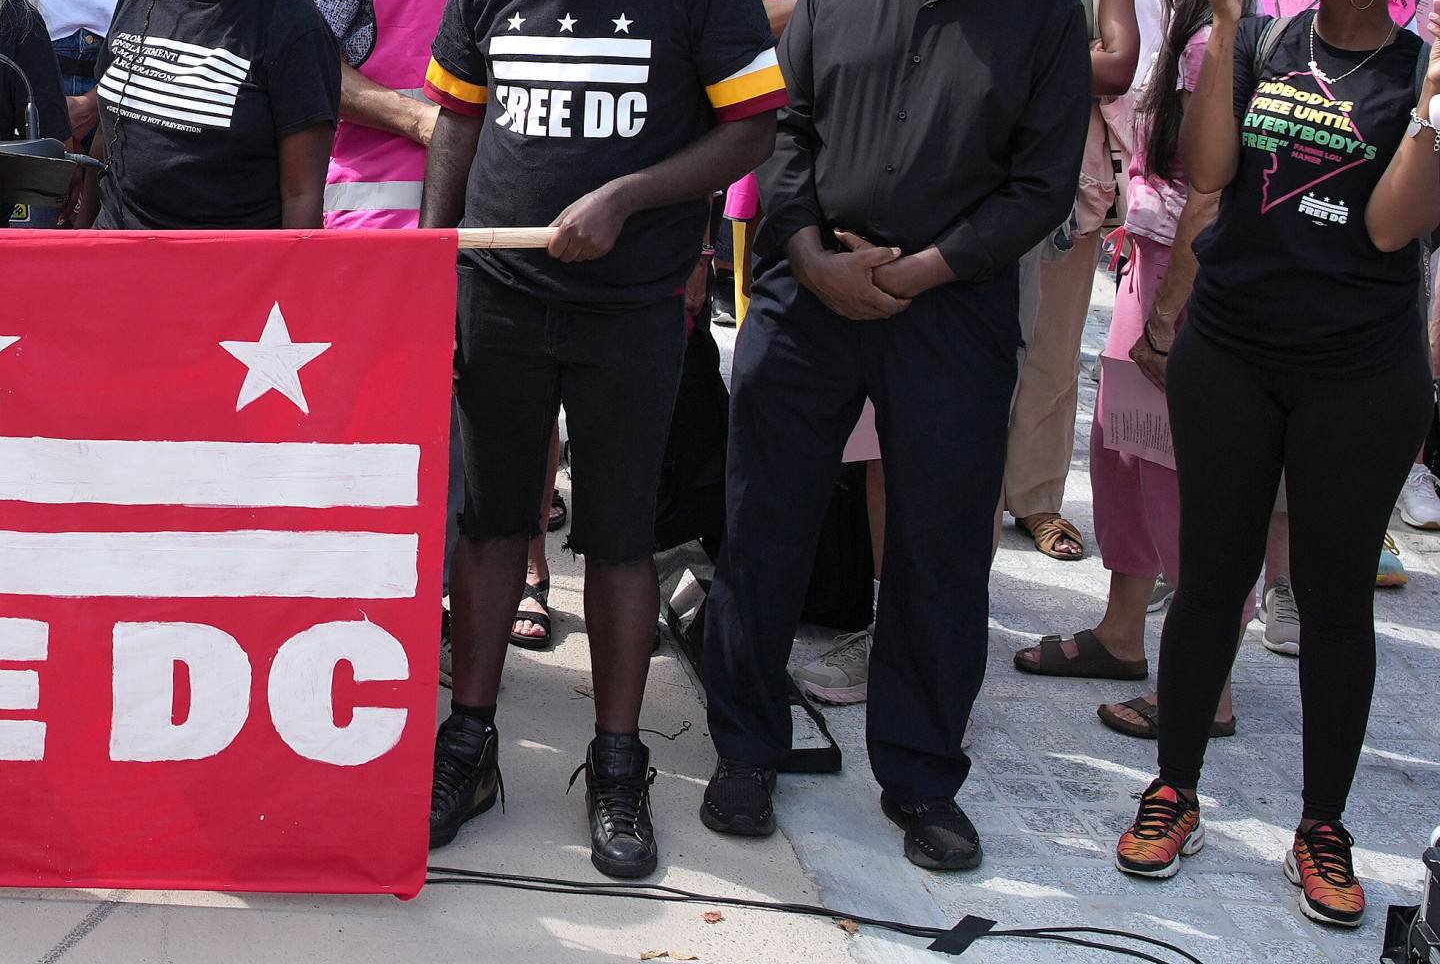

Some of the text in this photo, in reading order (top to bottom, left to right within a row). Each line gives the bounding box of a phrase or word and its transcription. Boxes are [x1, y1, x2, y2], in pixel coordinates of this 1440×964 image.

[140, 114, 147, 122] IS
[147, 116, 162, 125] NOT
[161, 120, 202, 134] PREVENTION
[495, 84, 648, 138] FREE DC
[1250, 96, 1354, 133] FREE UNTIL
[1243, 113, 1378, 162] EVERYBODY'S
[1324, 152, 1342, 163] LOU
[1298, 203, 1348, 224] FREE DC
[109, 613, 410, 767] DC
